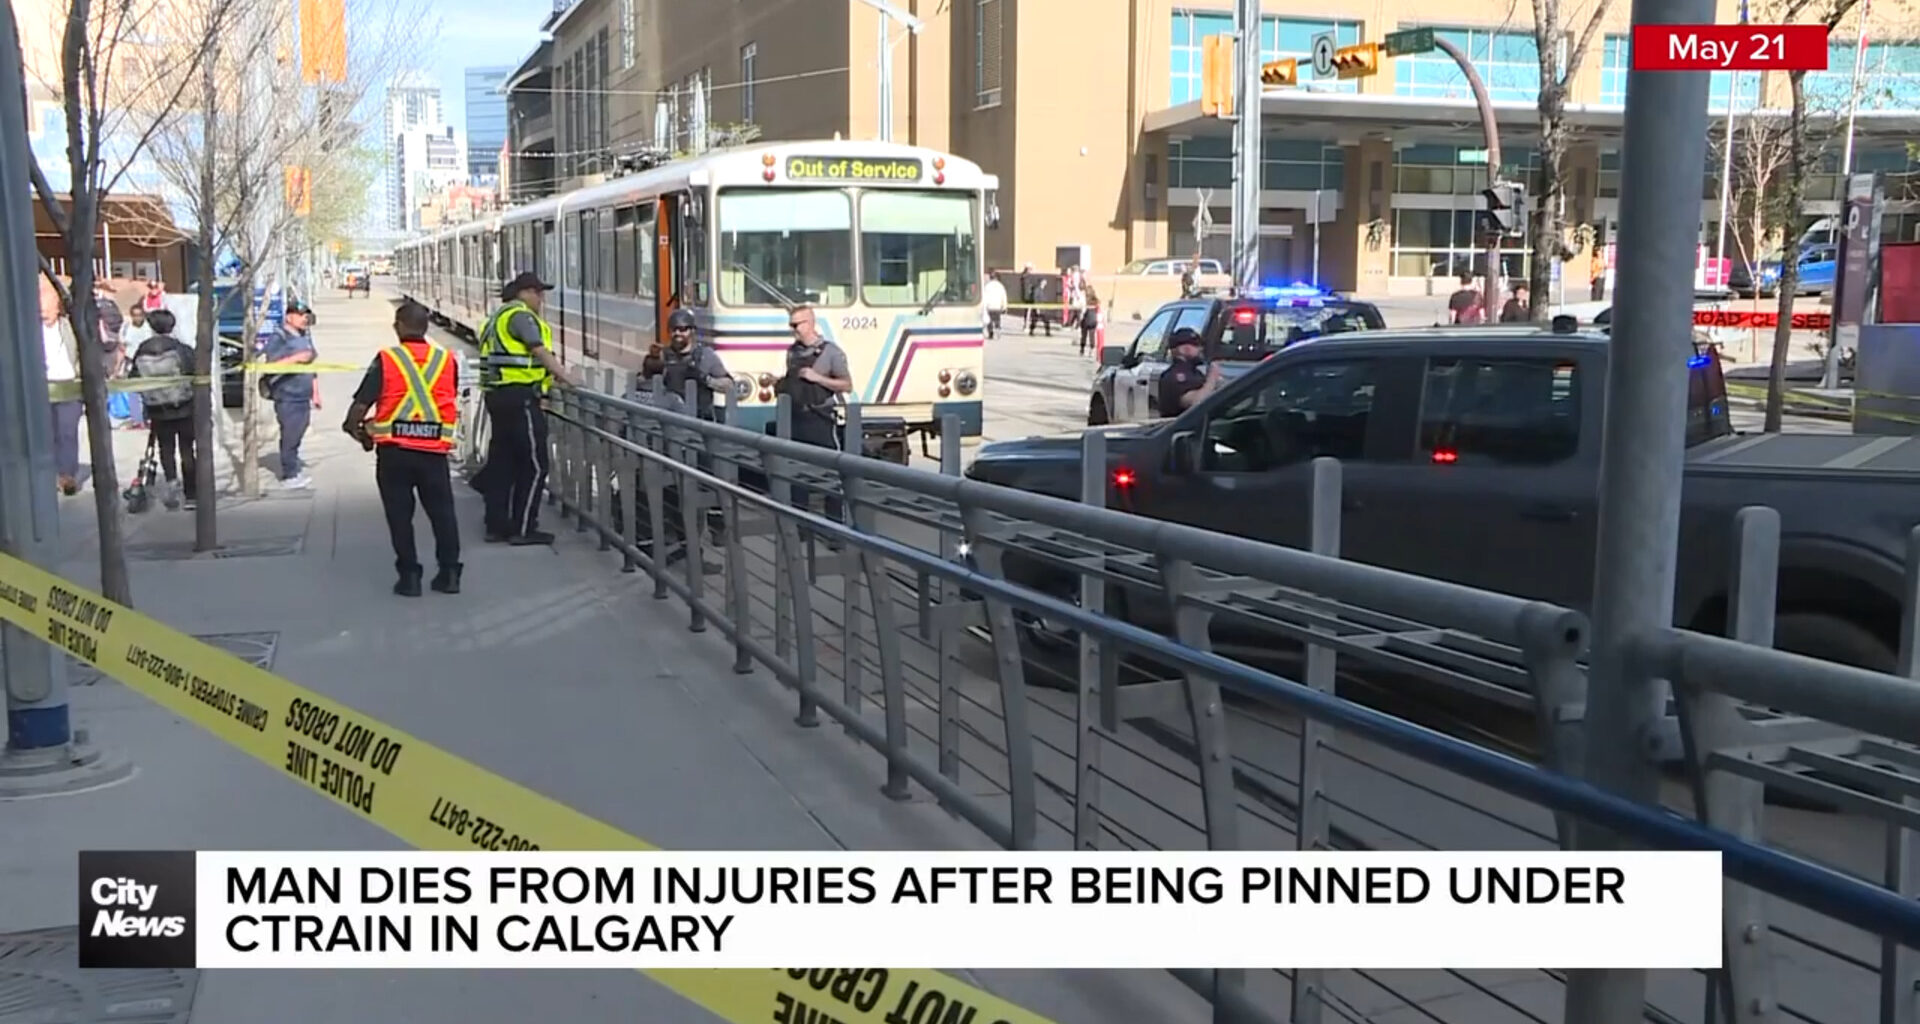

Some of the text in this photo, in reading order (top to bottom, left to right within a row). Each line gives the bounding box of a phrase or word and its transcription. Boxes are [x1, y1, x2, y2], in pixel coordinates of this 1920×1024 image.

[790, 160, 918, 179] Out of Service
[842, 316, 878, 330] 2024
[1693, 311, 1830, 329] ROAD CLSED
[395, 423, 440, 437] TRANSIT
[47, 585, 79, 618] CROSS
[75, 599, 100, 627] NOT
[94, 606, 113, 634] DO
[48, 618, 97, 663] POLICE LINE
[126, 644, 269, 732] CRIME STOPPERS 1-800-222-8477
[284, 697, 402, 776] DO NOT CROSS
[285, 740, 375, 814] POLICE LINE
[429, 796, 540, 851] 0-222-8477
